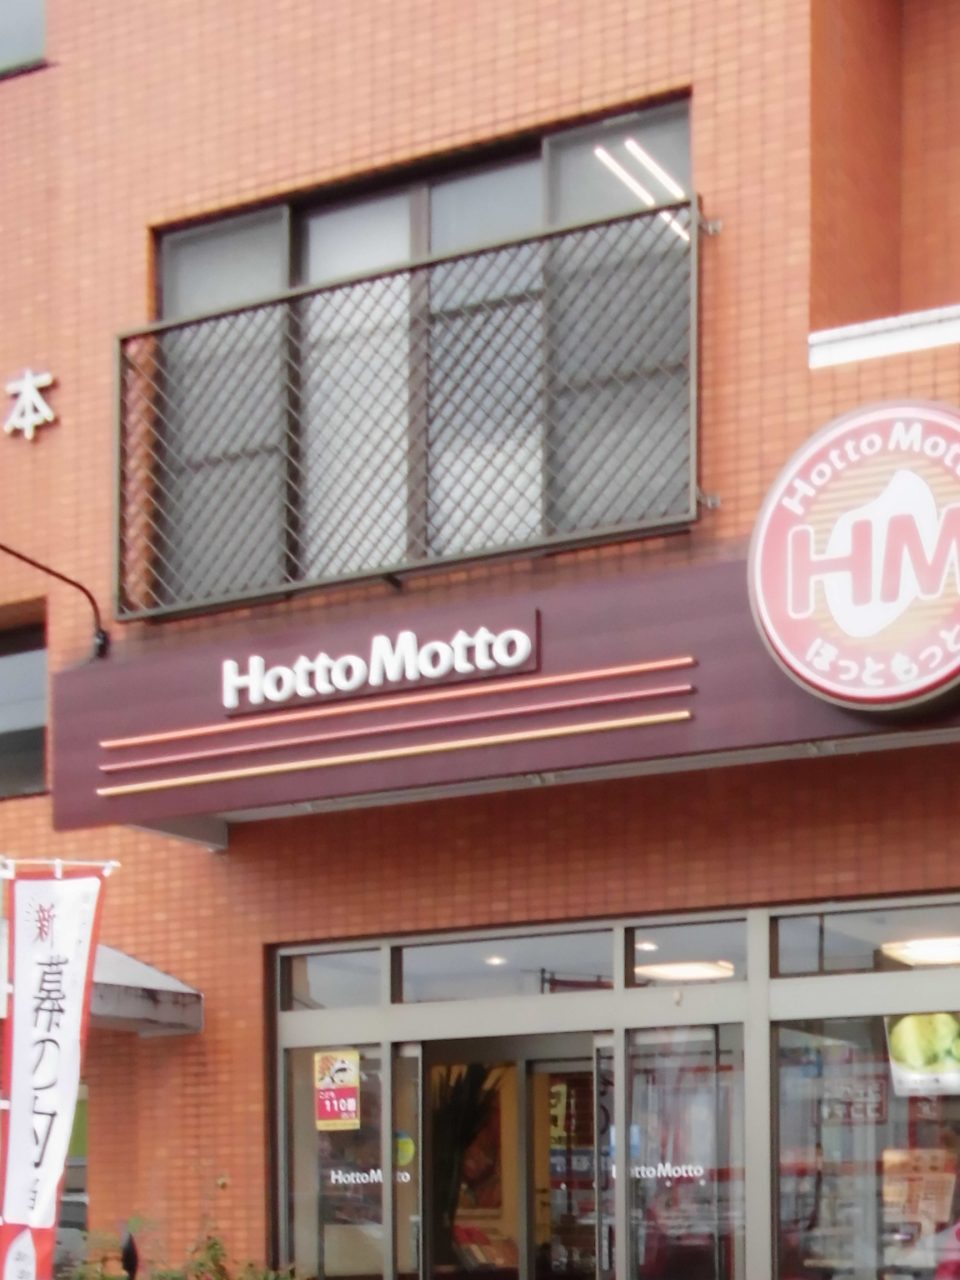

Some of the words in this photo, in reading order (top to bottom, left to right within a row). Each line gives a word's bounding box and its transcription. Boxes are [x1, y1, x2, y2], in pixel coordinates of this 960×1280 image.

[4, 369, 55, 441] 本
[222, 626, 531, 709] HottoMotto
[324, 1098, 356, 1112] 110
[331, 1169, 411, 1184] HottoMto
[612, 1162, 704, 1179] ttoMotto
